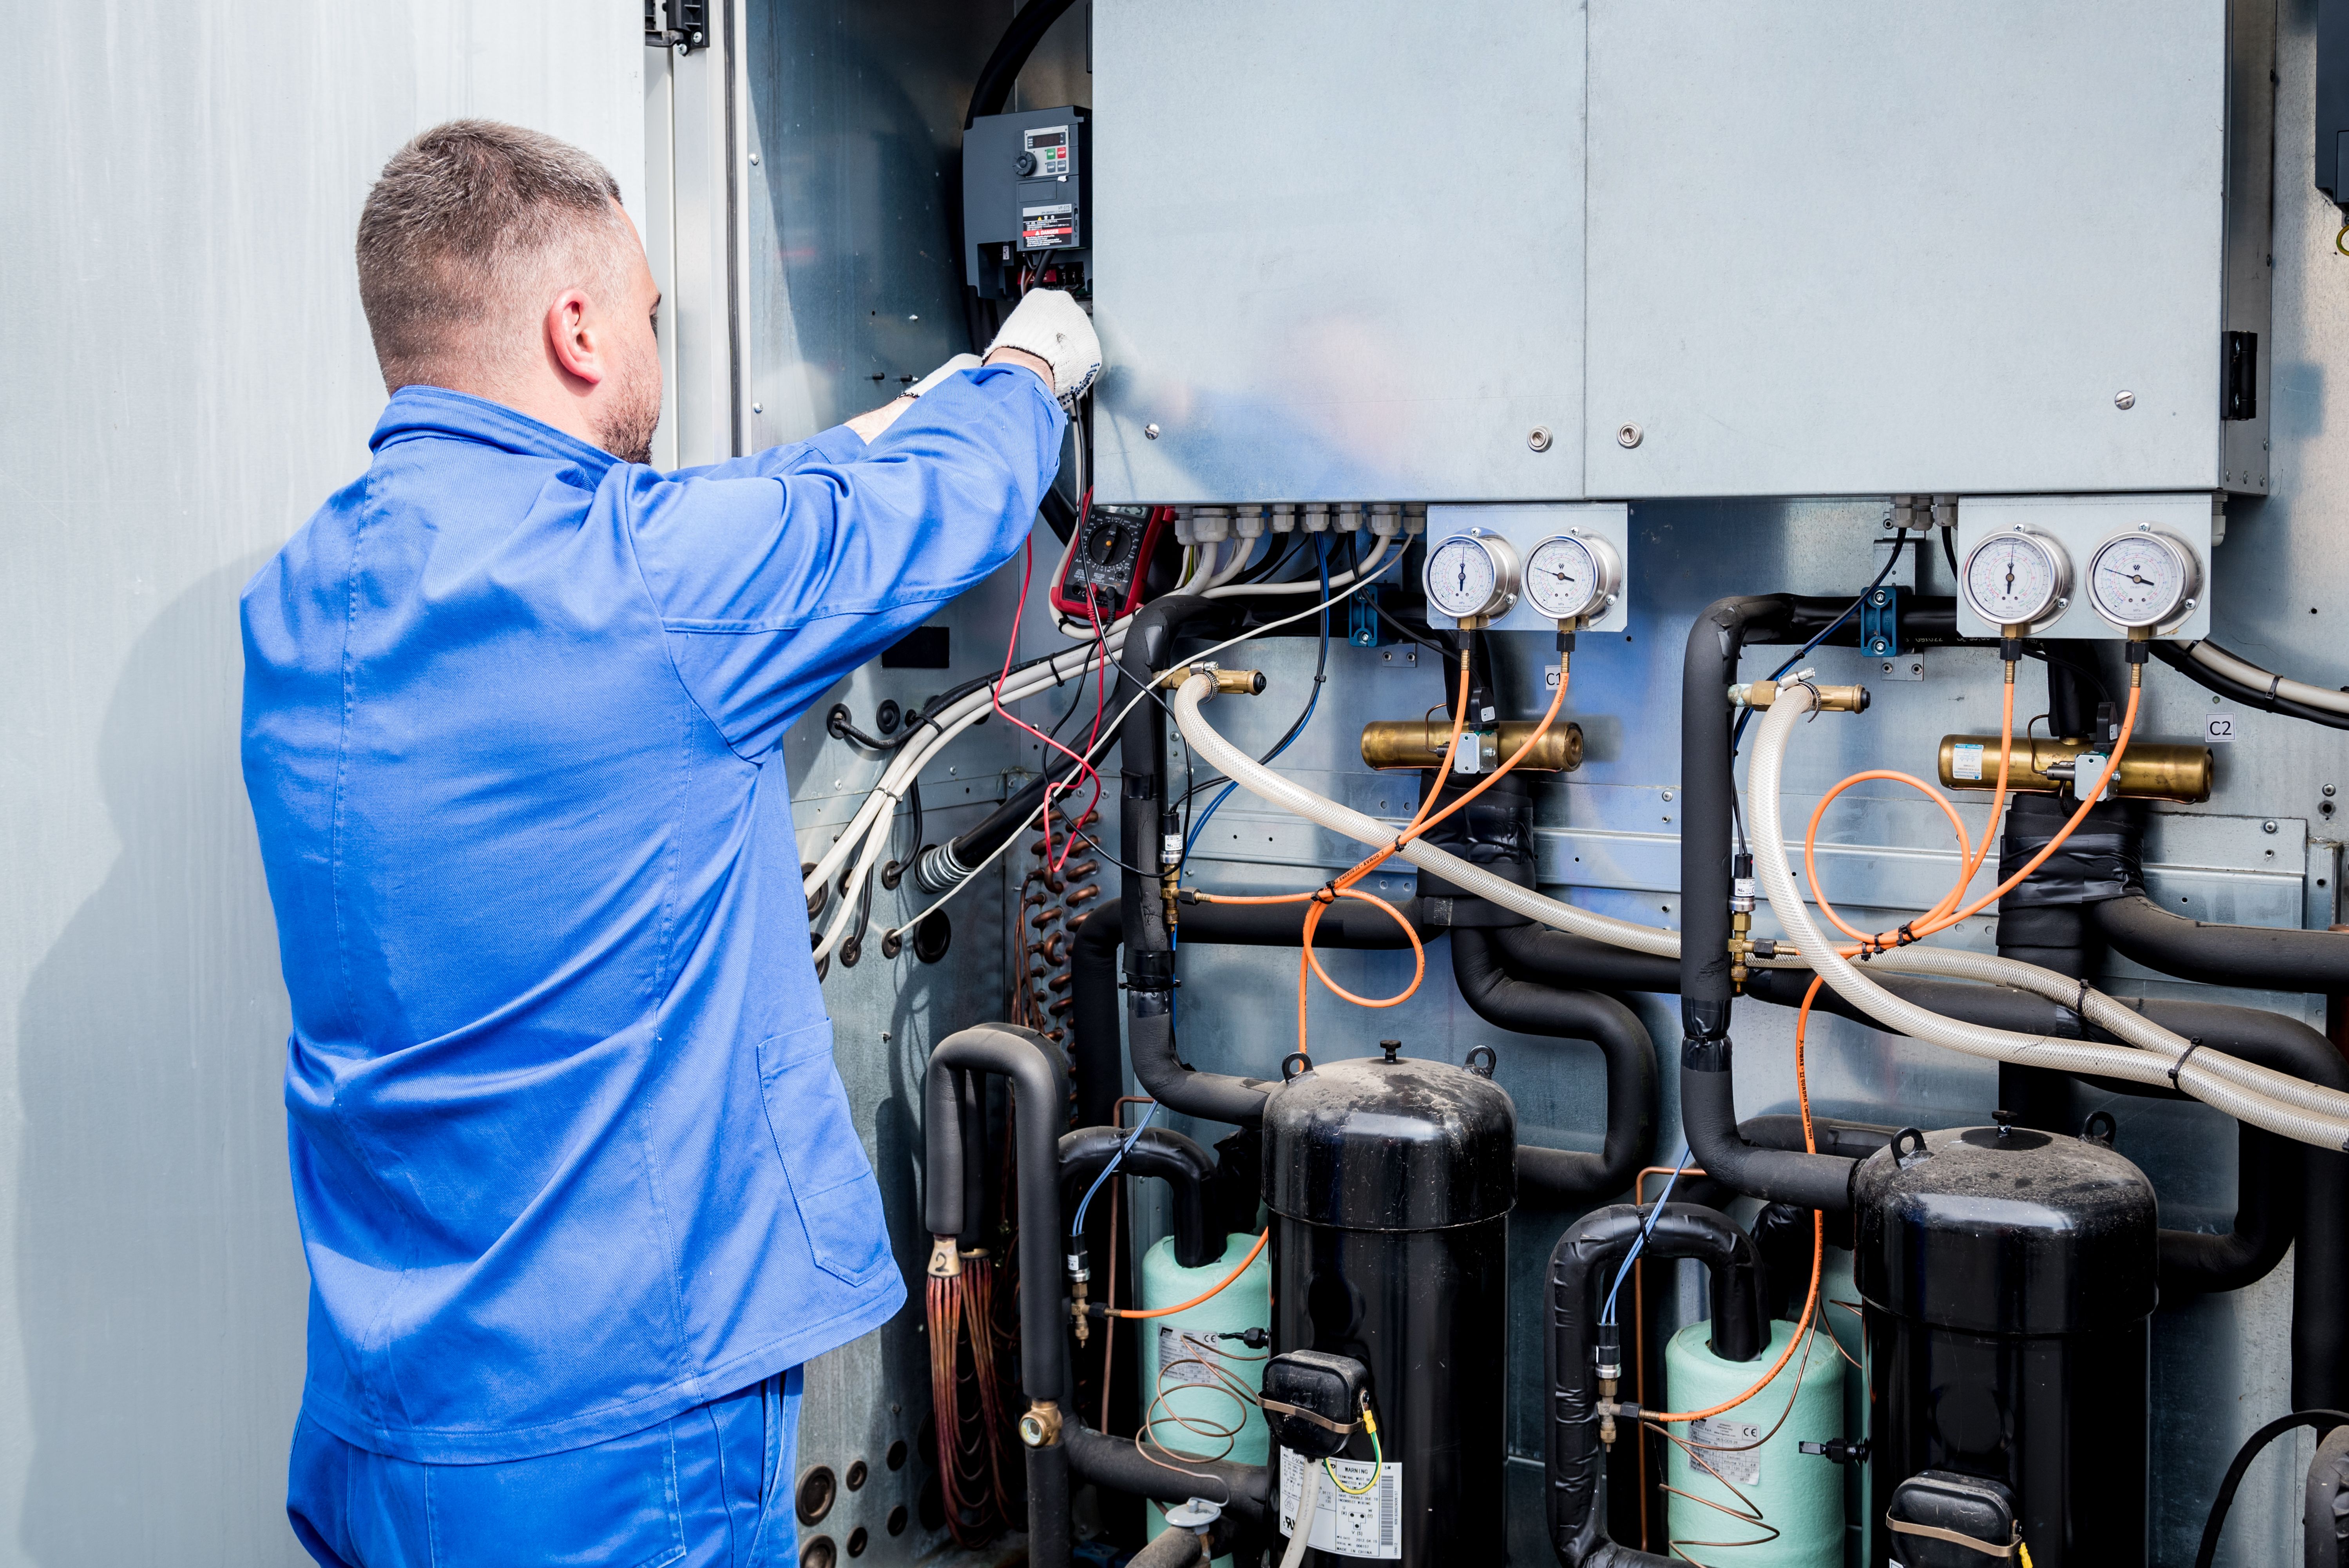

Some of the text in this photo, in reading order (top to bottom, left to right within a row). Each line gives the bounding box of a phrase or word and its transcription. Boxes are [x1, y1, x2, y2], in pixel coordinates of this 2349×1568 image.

[1546, 673, 1561, 686] C1
[2209, 721, 2232, 736] C2
[1819, 1225, 1822, 1233] EN
[935, 1252, 949, 1272] 2
[1744, 1428, 1757, 1437] CE
